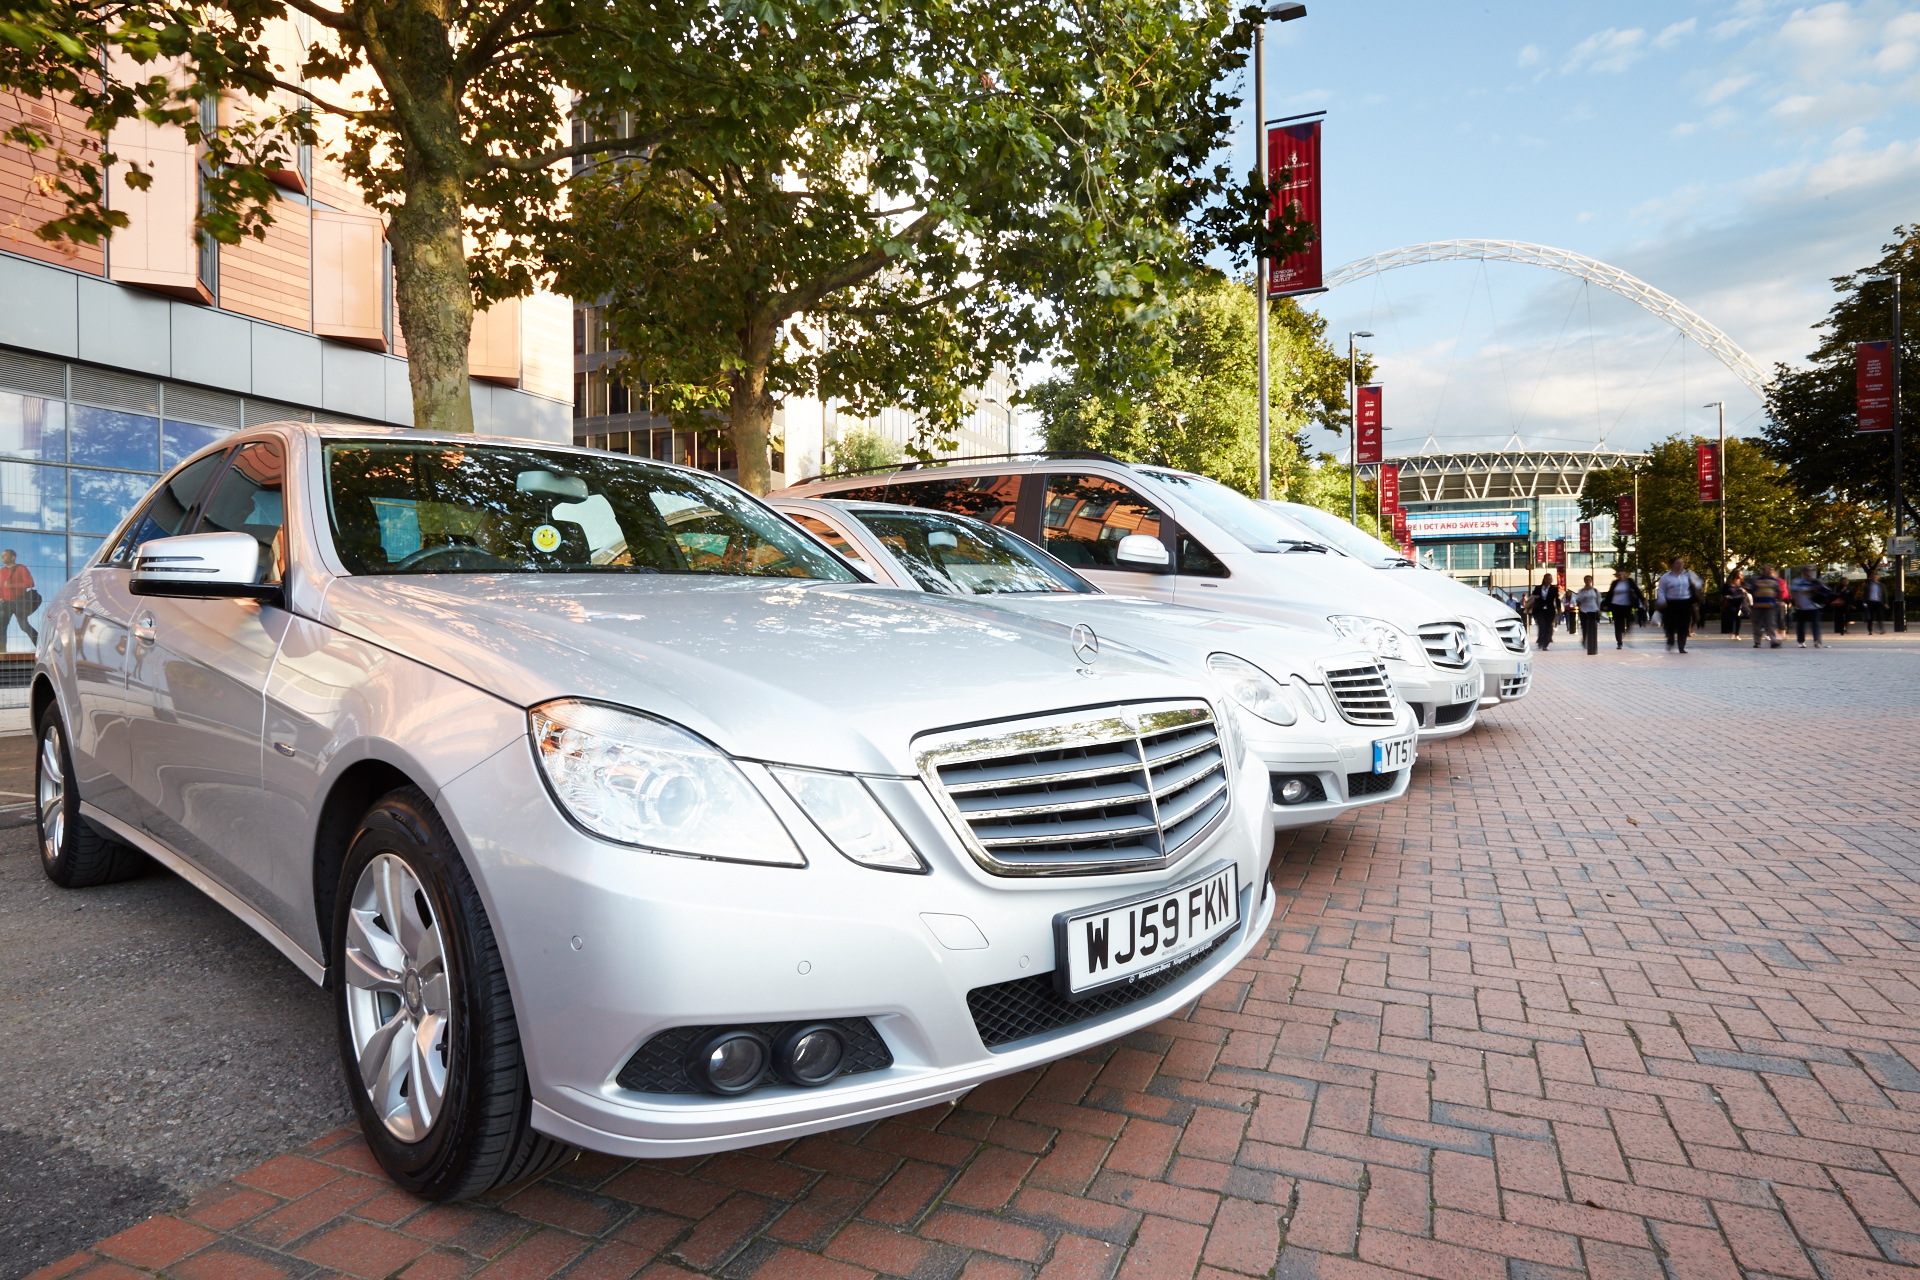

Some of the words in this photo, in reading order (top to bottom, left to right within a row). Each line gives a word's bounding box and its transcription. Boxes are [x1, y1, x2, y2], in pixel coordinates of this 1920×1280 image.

[1459, 521, 1478, 529] SAVE
[1480, 520, 1499, 528] 25%
[1385, 738, 1412, 766] YT57
[1086, 898, 1179, 974] WJ59
[1188, 873, 1229, 938] FKN
